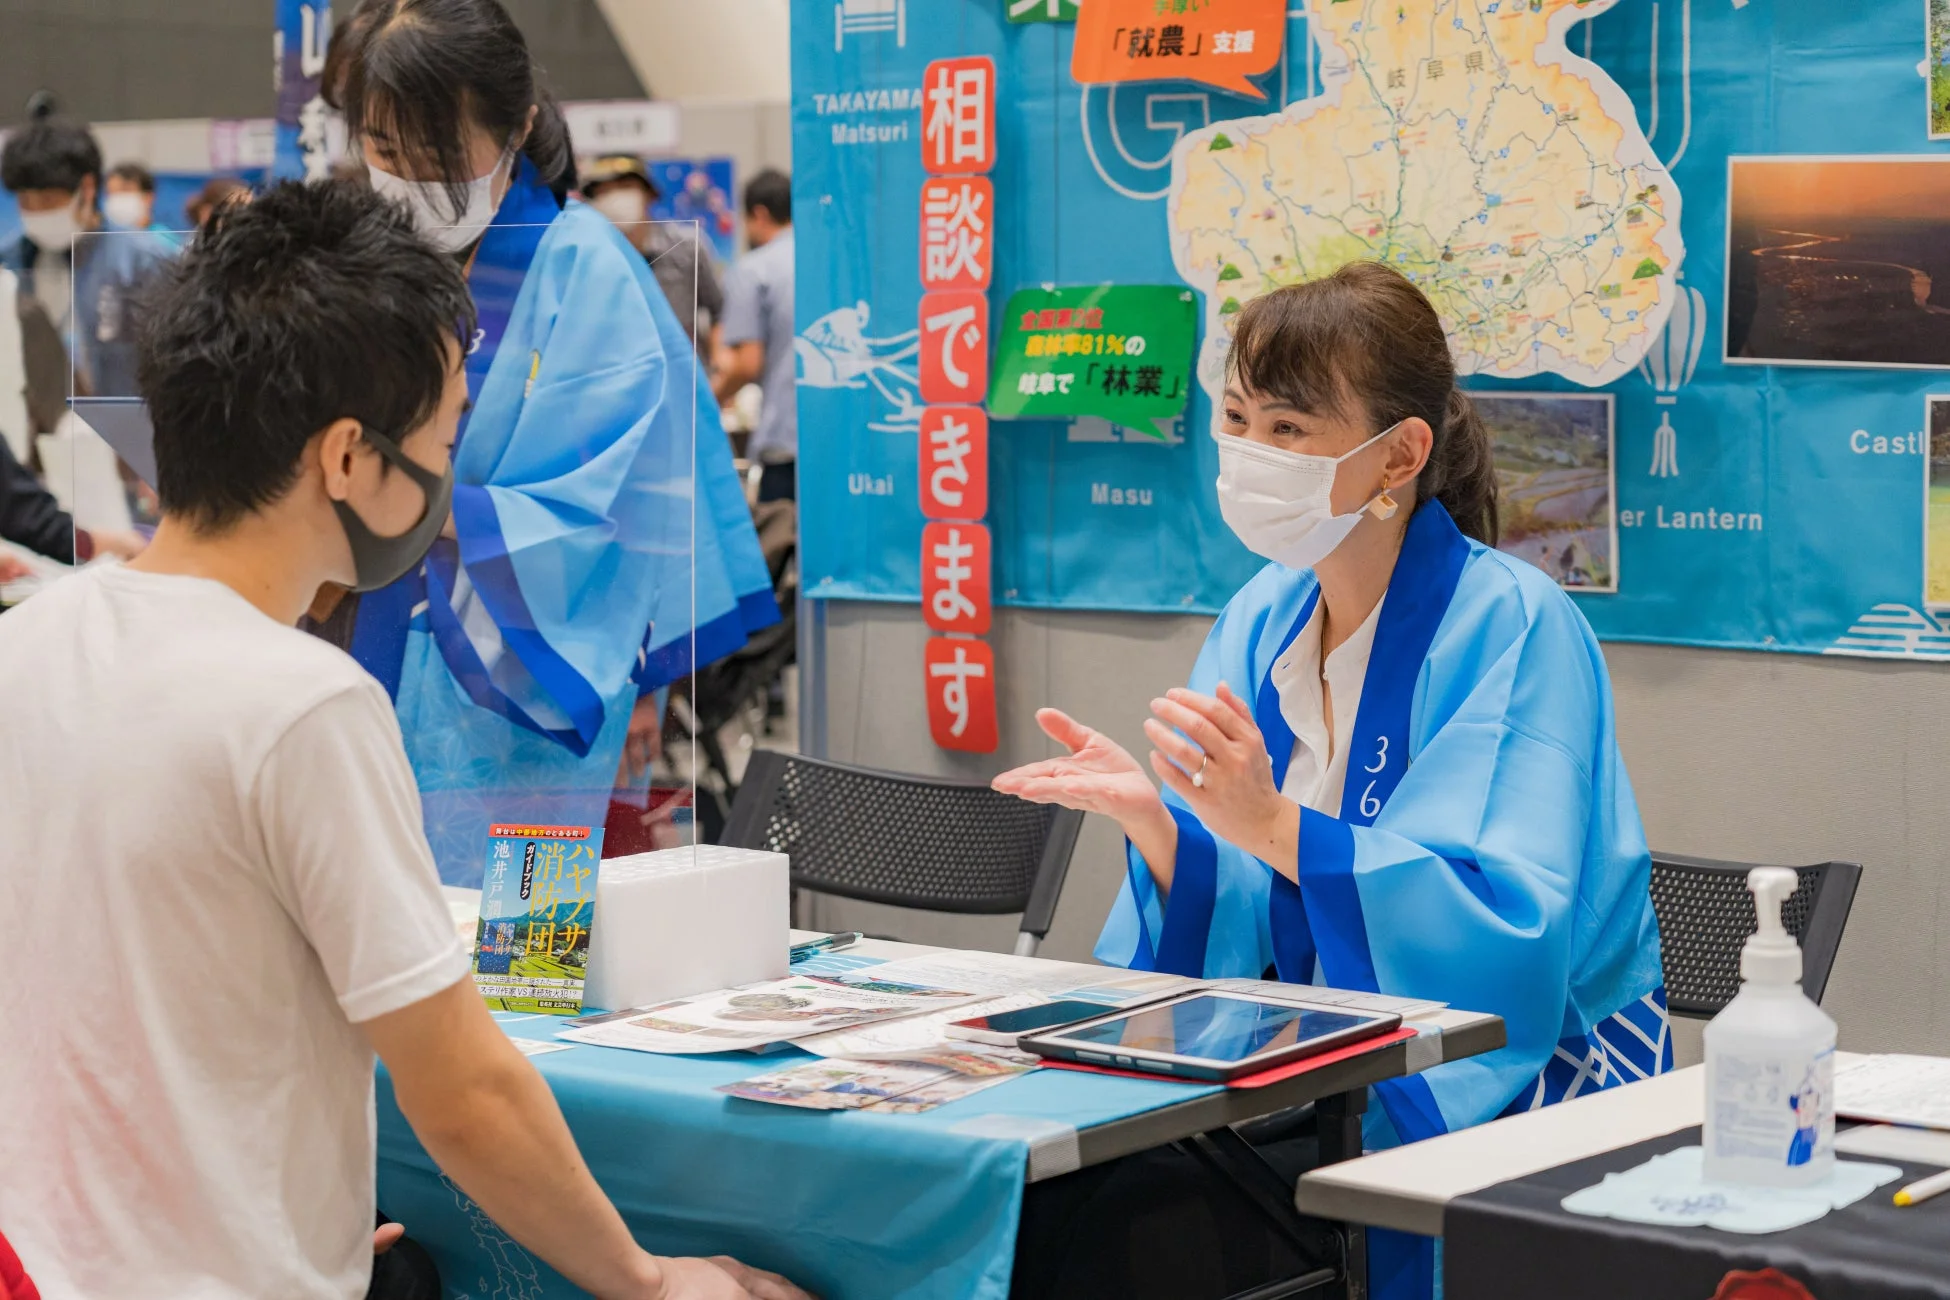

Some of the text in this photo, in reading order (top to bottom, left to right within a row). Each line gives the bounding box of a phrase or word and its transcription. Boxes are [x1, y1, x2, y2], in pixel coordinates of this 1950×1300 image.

[1386, 50, 1485, 90] 岐阜県
[813, 88, 923, 115] TAKAYAMA
[831, 121, 909, 145] Matsuri
[925, 66, 988, 738] 相談できます
[1850, 429, 1925, 455] Castl
[848, 473, 894, 496] Ukai
[1090, 482, 1154, 506] Masu
[1619, 505, 1764, 531] er Lantern
[520, 844, 535, 899] ガイドブック
[523, 842, 565, 958] 消防団
[557, 844, 596, 958] ハヤブサ
